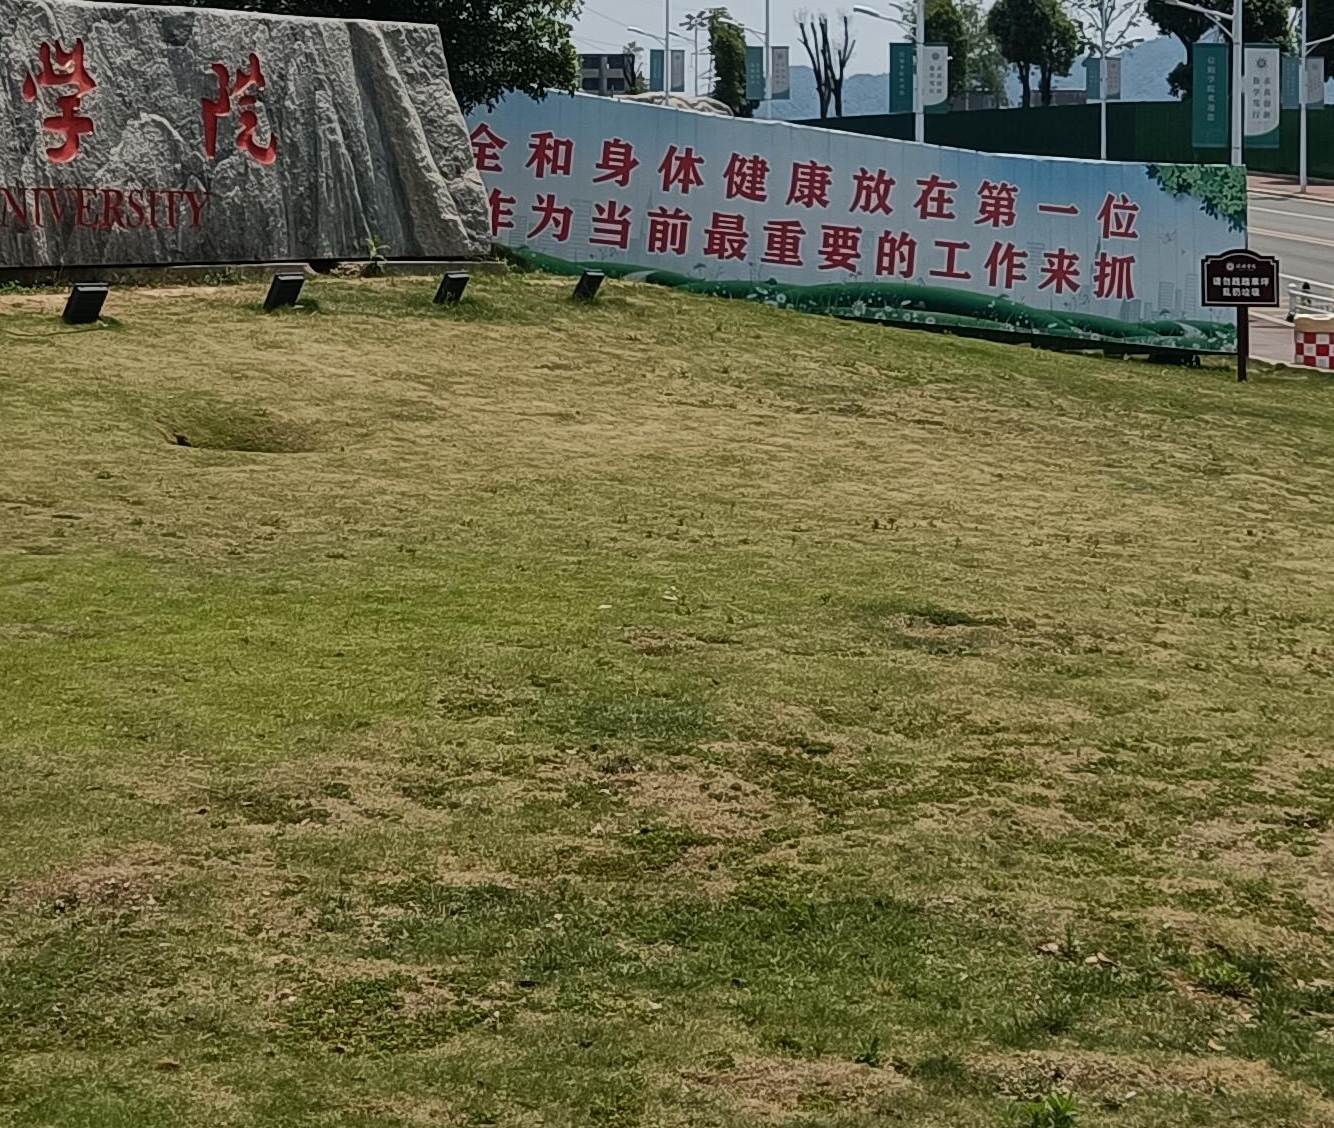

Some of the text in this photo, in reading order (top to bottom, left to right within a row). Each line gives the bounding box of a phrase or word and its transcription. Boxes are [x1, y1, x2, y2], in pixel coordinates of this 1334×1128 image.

[470, 122, 1140, 240] 全和身体健康放在第一位
[489, 187, 1136, 301] 作为当前最重要的工作来抓
